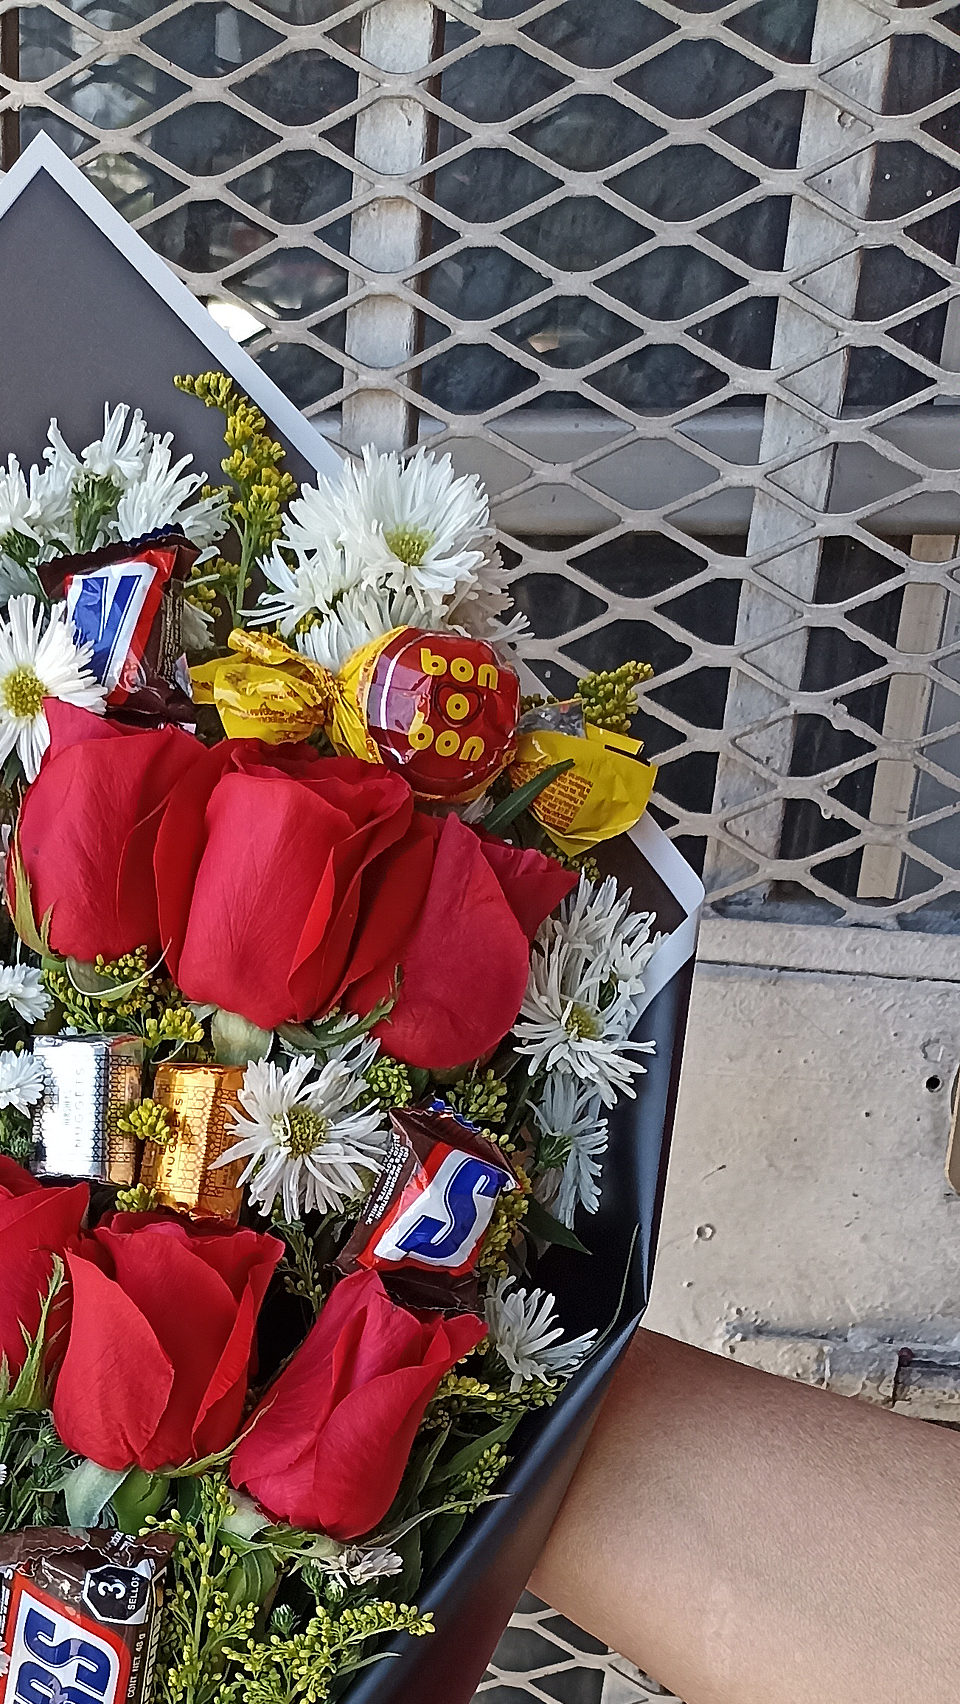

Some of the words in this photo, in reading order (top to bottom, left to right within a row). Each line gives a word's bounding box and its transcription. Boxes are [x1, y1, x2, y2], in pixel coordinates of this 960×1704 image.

[420, 647, 499, 691] bon
[408, 710, 485, 762] bon
[74, 1067, 85, 1148] NUGGETS
[395, 1157, 510, 1259] S
[97, 1579, 127, 1601] 3
[127, 1576, 141, 1611] SELLOS
